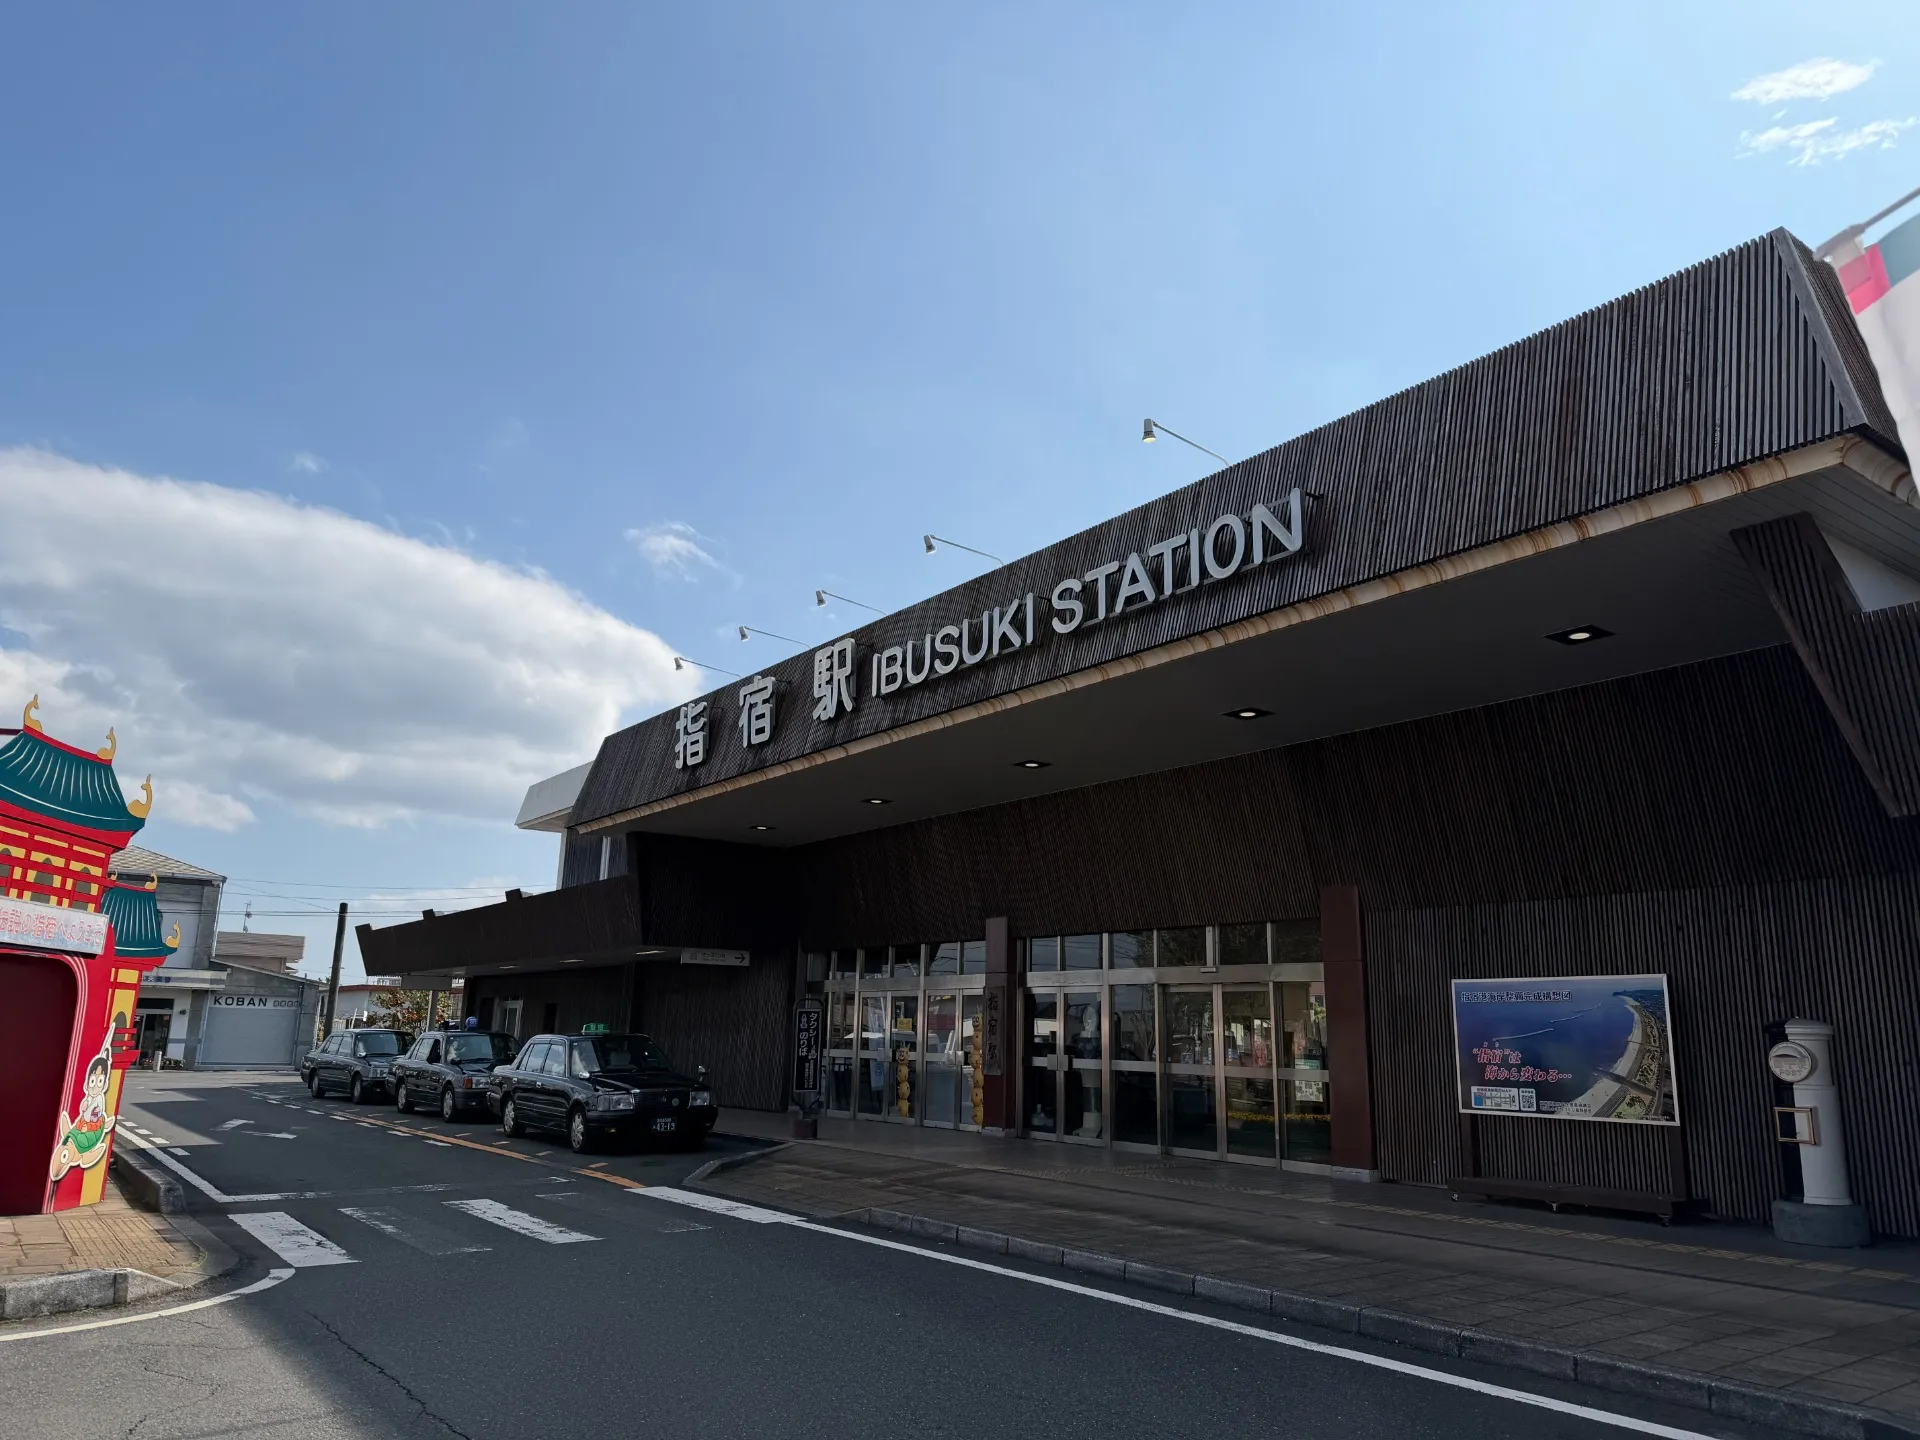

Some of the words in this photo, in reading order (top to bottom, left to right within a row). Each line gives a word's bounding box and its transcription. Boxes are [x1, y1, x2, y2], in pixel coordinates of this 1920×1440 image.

[675, 638, 855, 770] 指宿駅
[871, 592, 1035, 697] IBUSUKI
[1050, 487, 1305, 634] STATION
[213, 996, 268, 1007] KOBAN
[799, 1031, 809, 1057] のりば
[808, 1012, 818, 1046] タクシー
